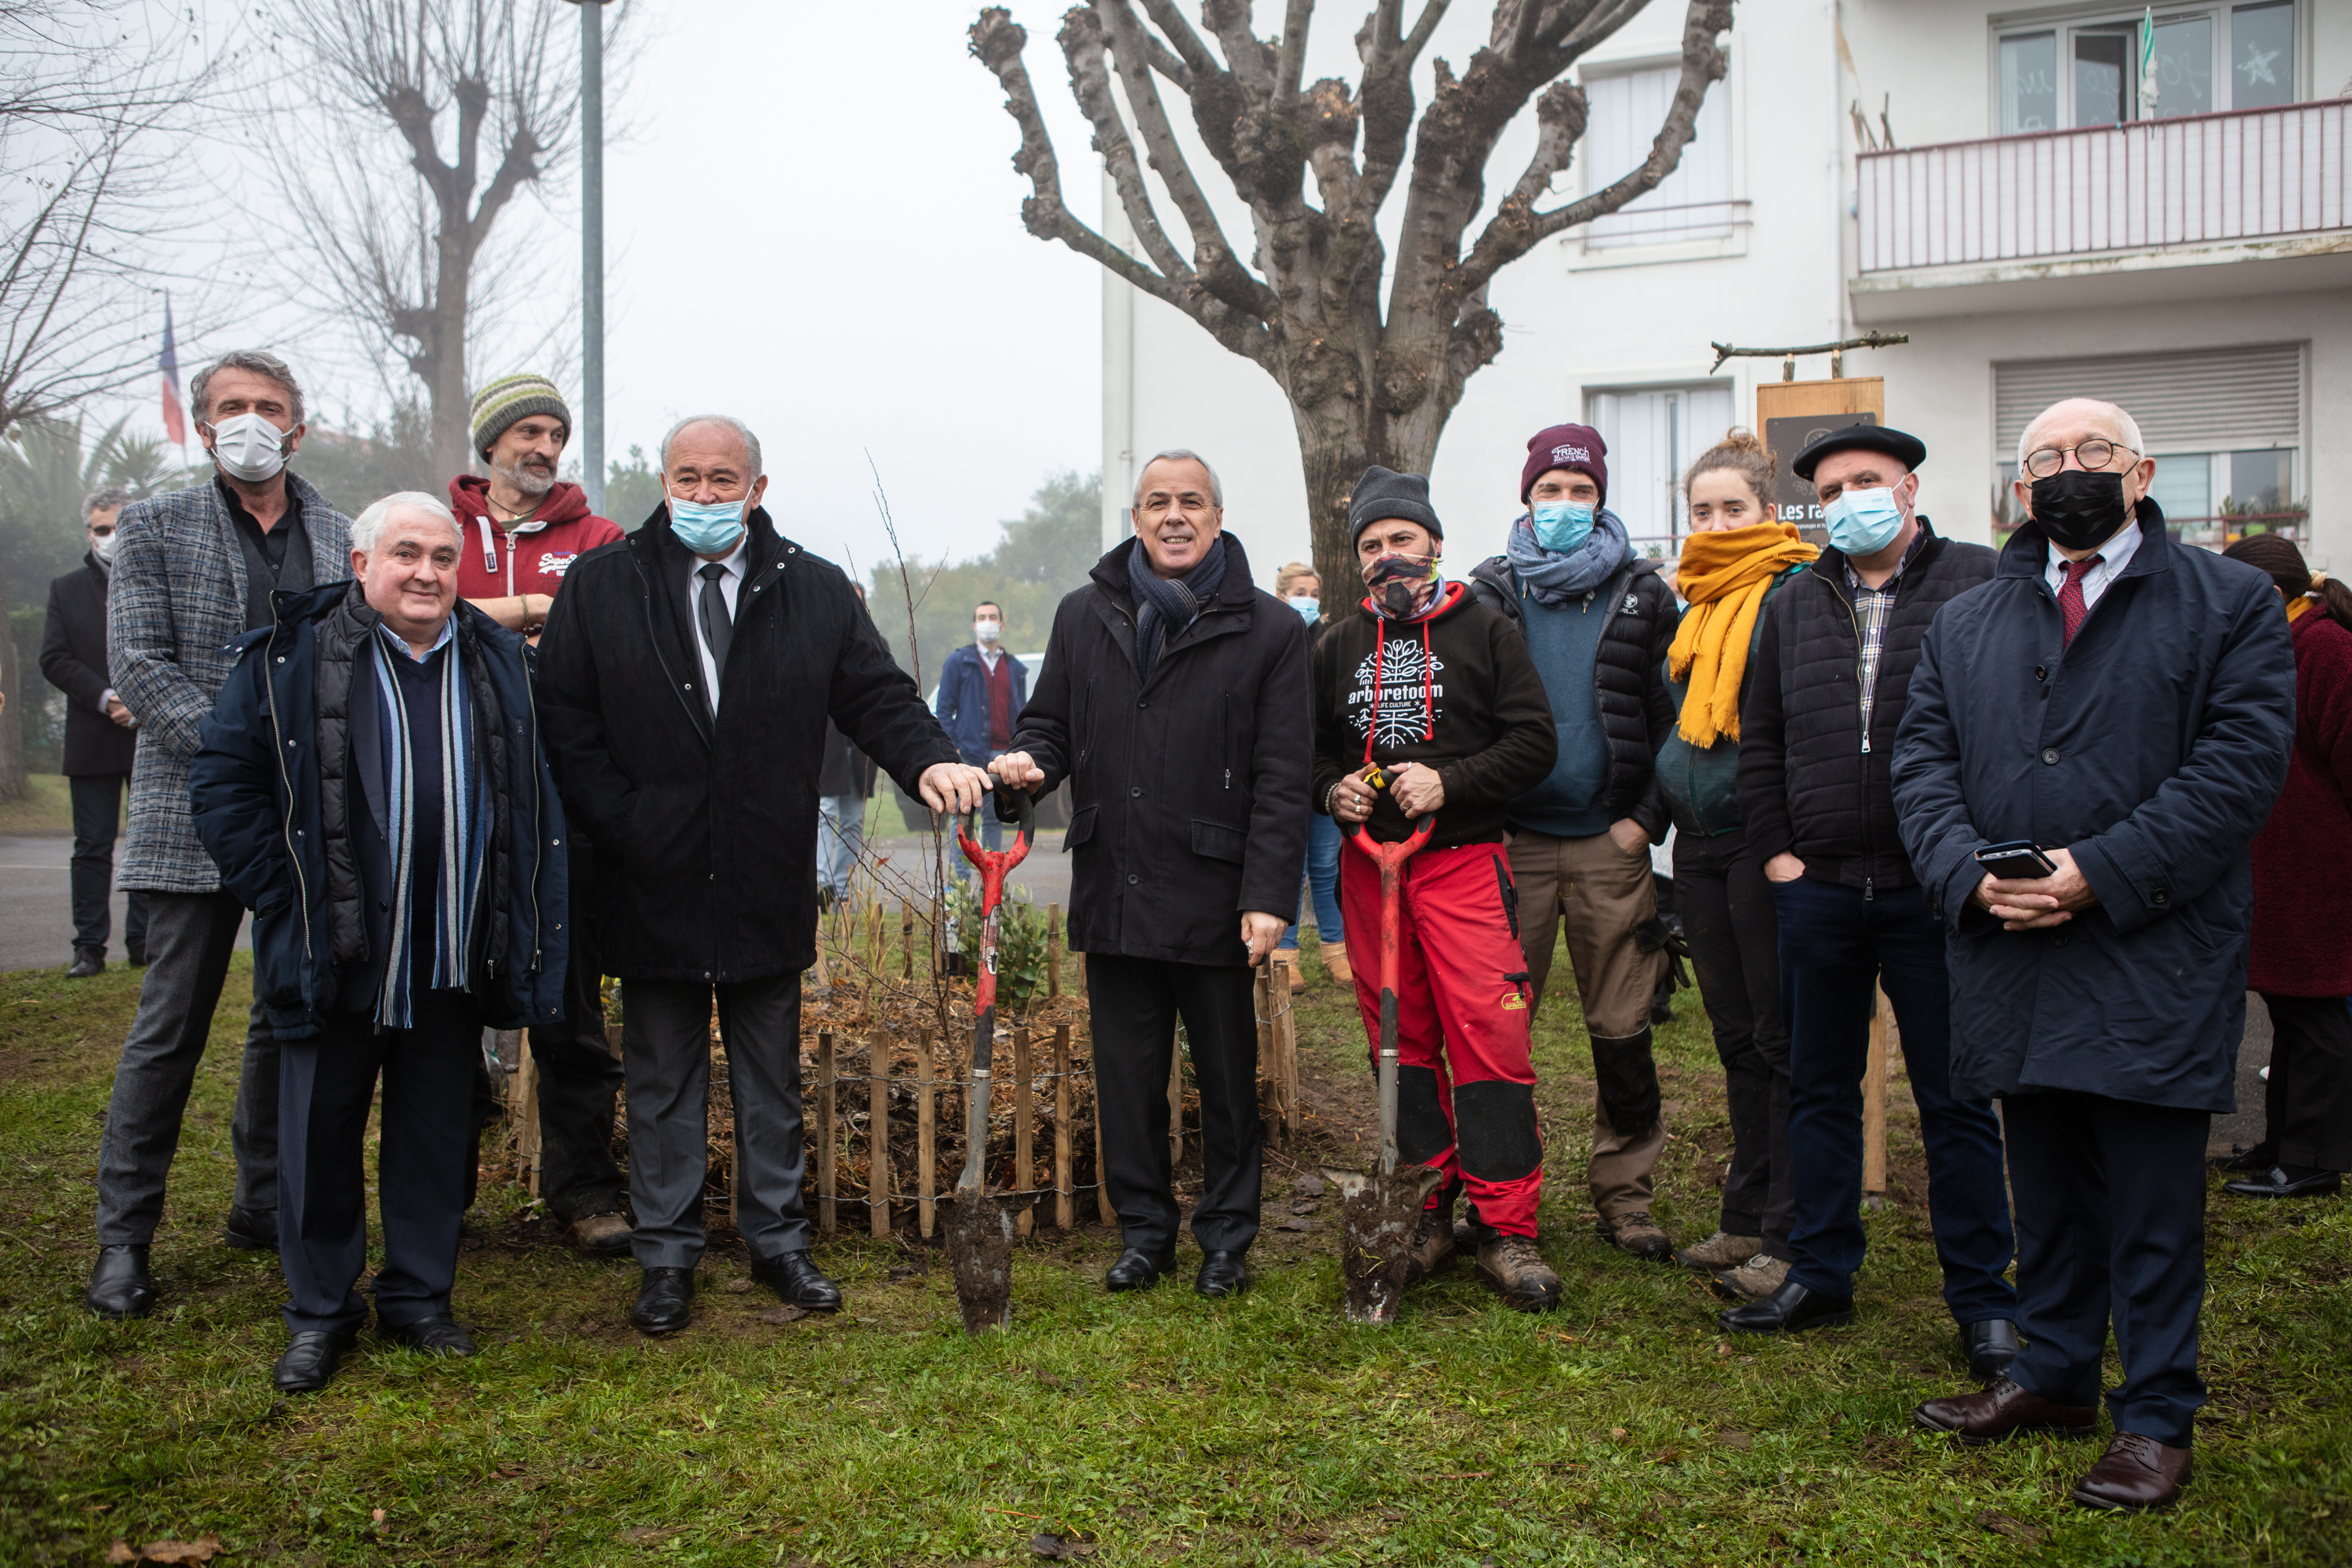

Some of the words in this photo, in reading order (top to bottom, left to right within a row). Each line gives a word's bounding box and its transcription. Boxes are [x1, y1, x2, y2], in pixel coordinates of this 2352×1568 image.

[1777, 504, 1804, 521] Les
[1808, 504, 1824, 519] ra
[1348, 684, 1443, 705] arboretoom
